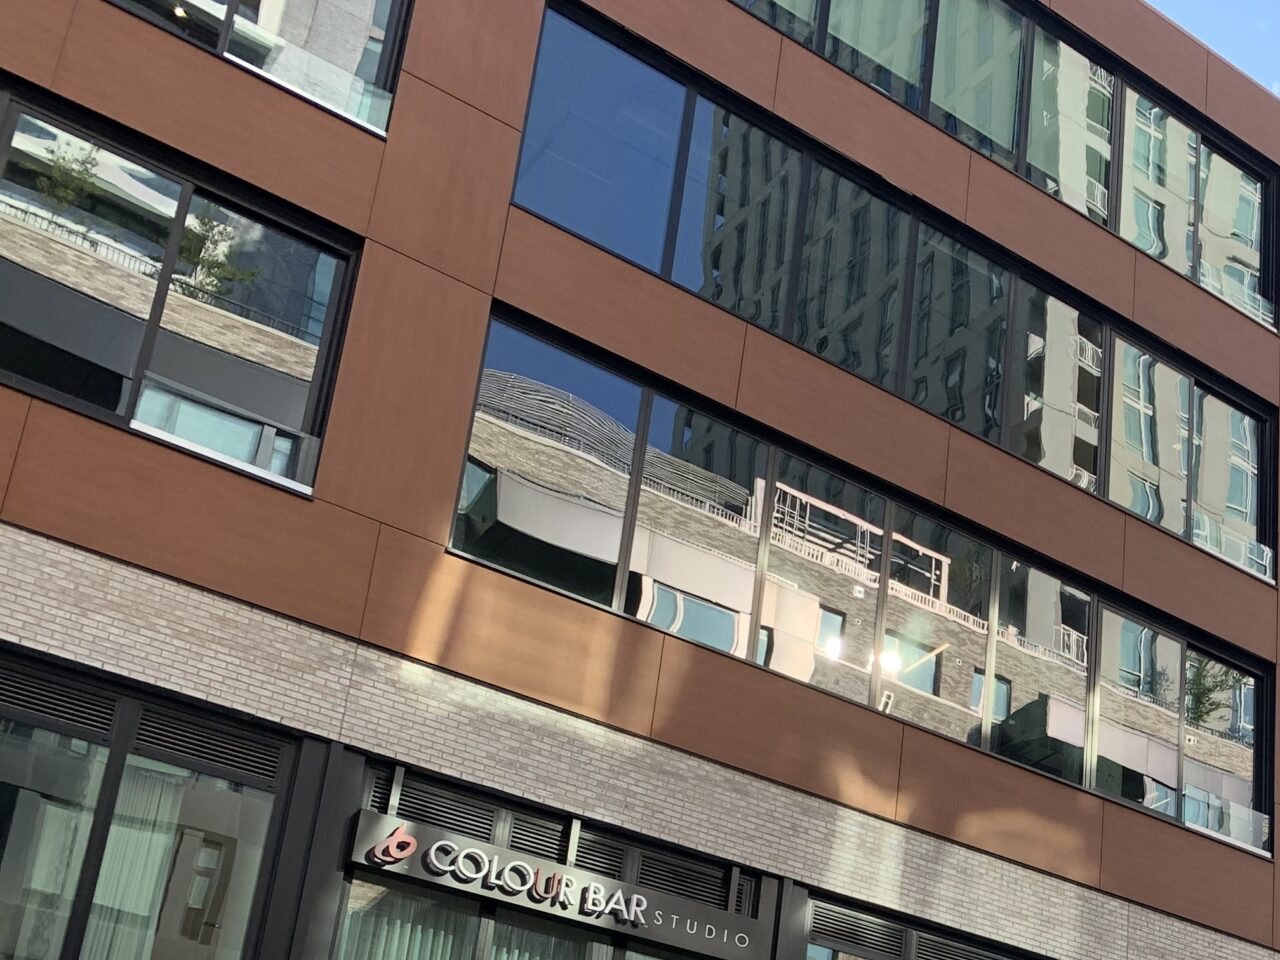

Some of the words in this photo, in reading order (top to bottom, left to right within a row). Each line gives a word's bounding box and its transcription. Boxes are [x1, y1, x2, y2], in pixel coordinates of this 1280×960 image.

[428, 839, 577, 907] COLOUR
[586, 882, 648, 925] BAR
[653, 910, 750, 949] STUDIO
